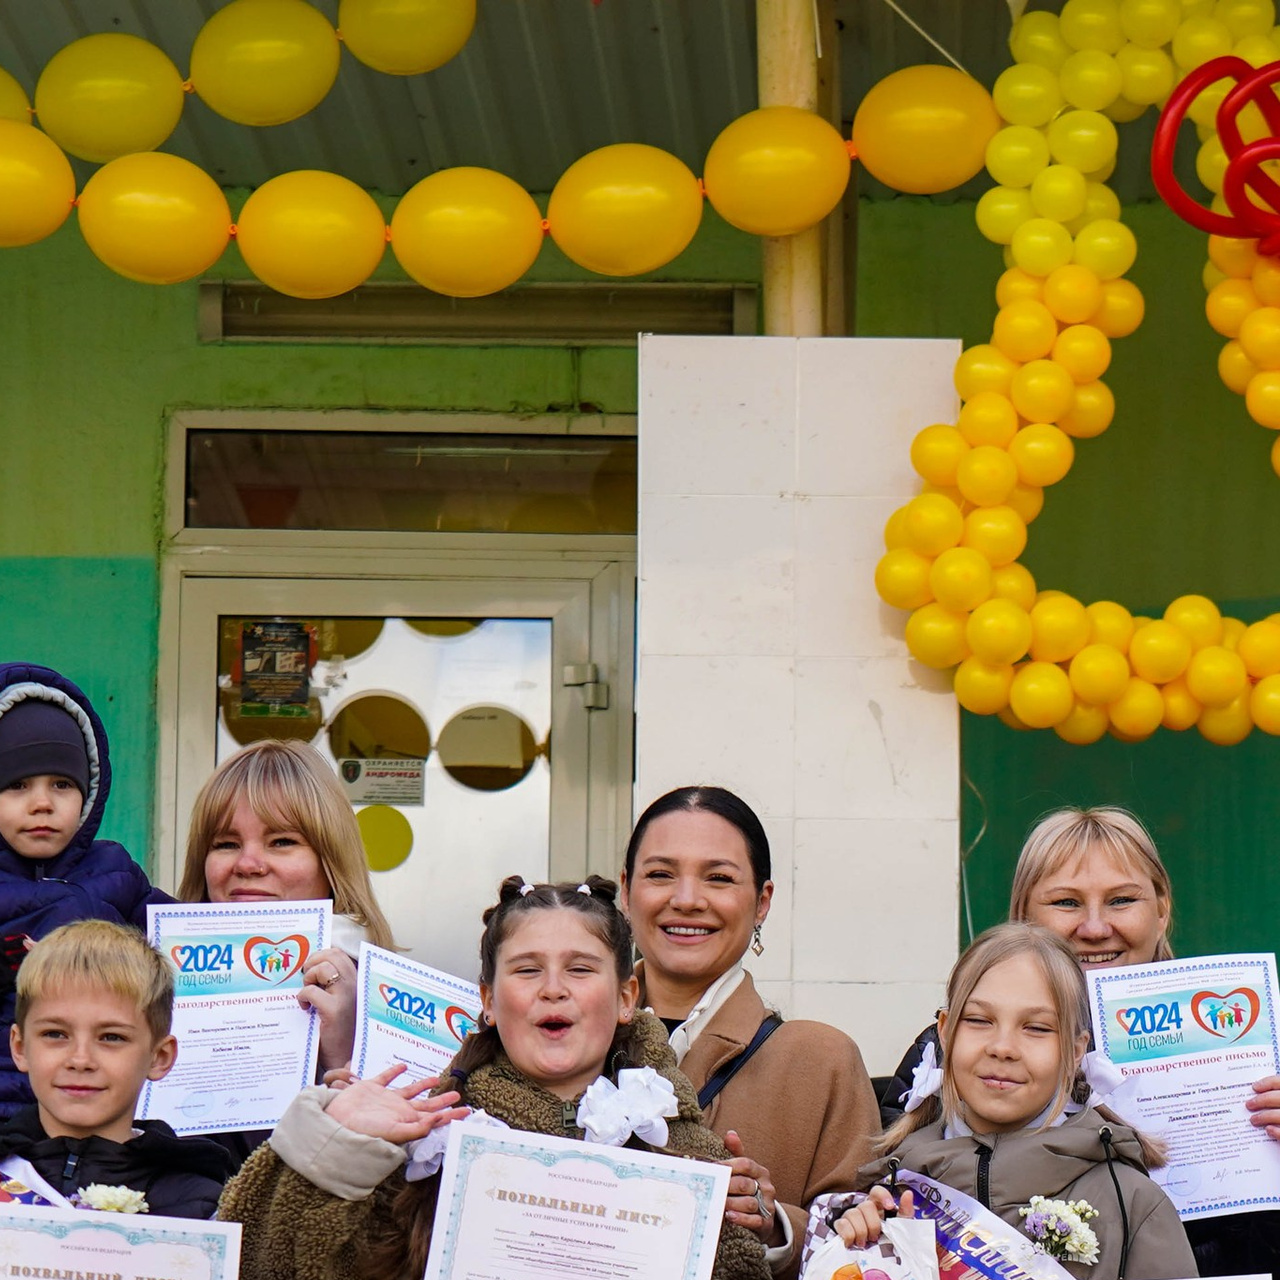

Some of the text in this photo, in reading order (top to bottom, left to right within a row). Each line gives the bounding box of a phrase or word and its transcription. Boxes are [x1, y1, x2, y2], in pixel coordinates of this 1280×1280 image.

[180, 944, 234, 973] 2024
[172, 996, 262, 1010] лагодарственное
[265, 994, 299, 1004] письм
[387, 987, 436, 1024] 2024
[1125, 1002, 1183, 1036] 2024
[376, 1024, 454, 1059] Благодарственн
[1128, 1037, 1147, 1051] ГОД
[1120, 1055, 1222, 1077] Благодарственное
[1225, 1051, 1267, 1062] письмо
[497, 1189, 661, 1227] ПОХВАЛЬНЫЙ ЛИСТ
